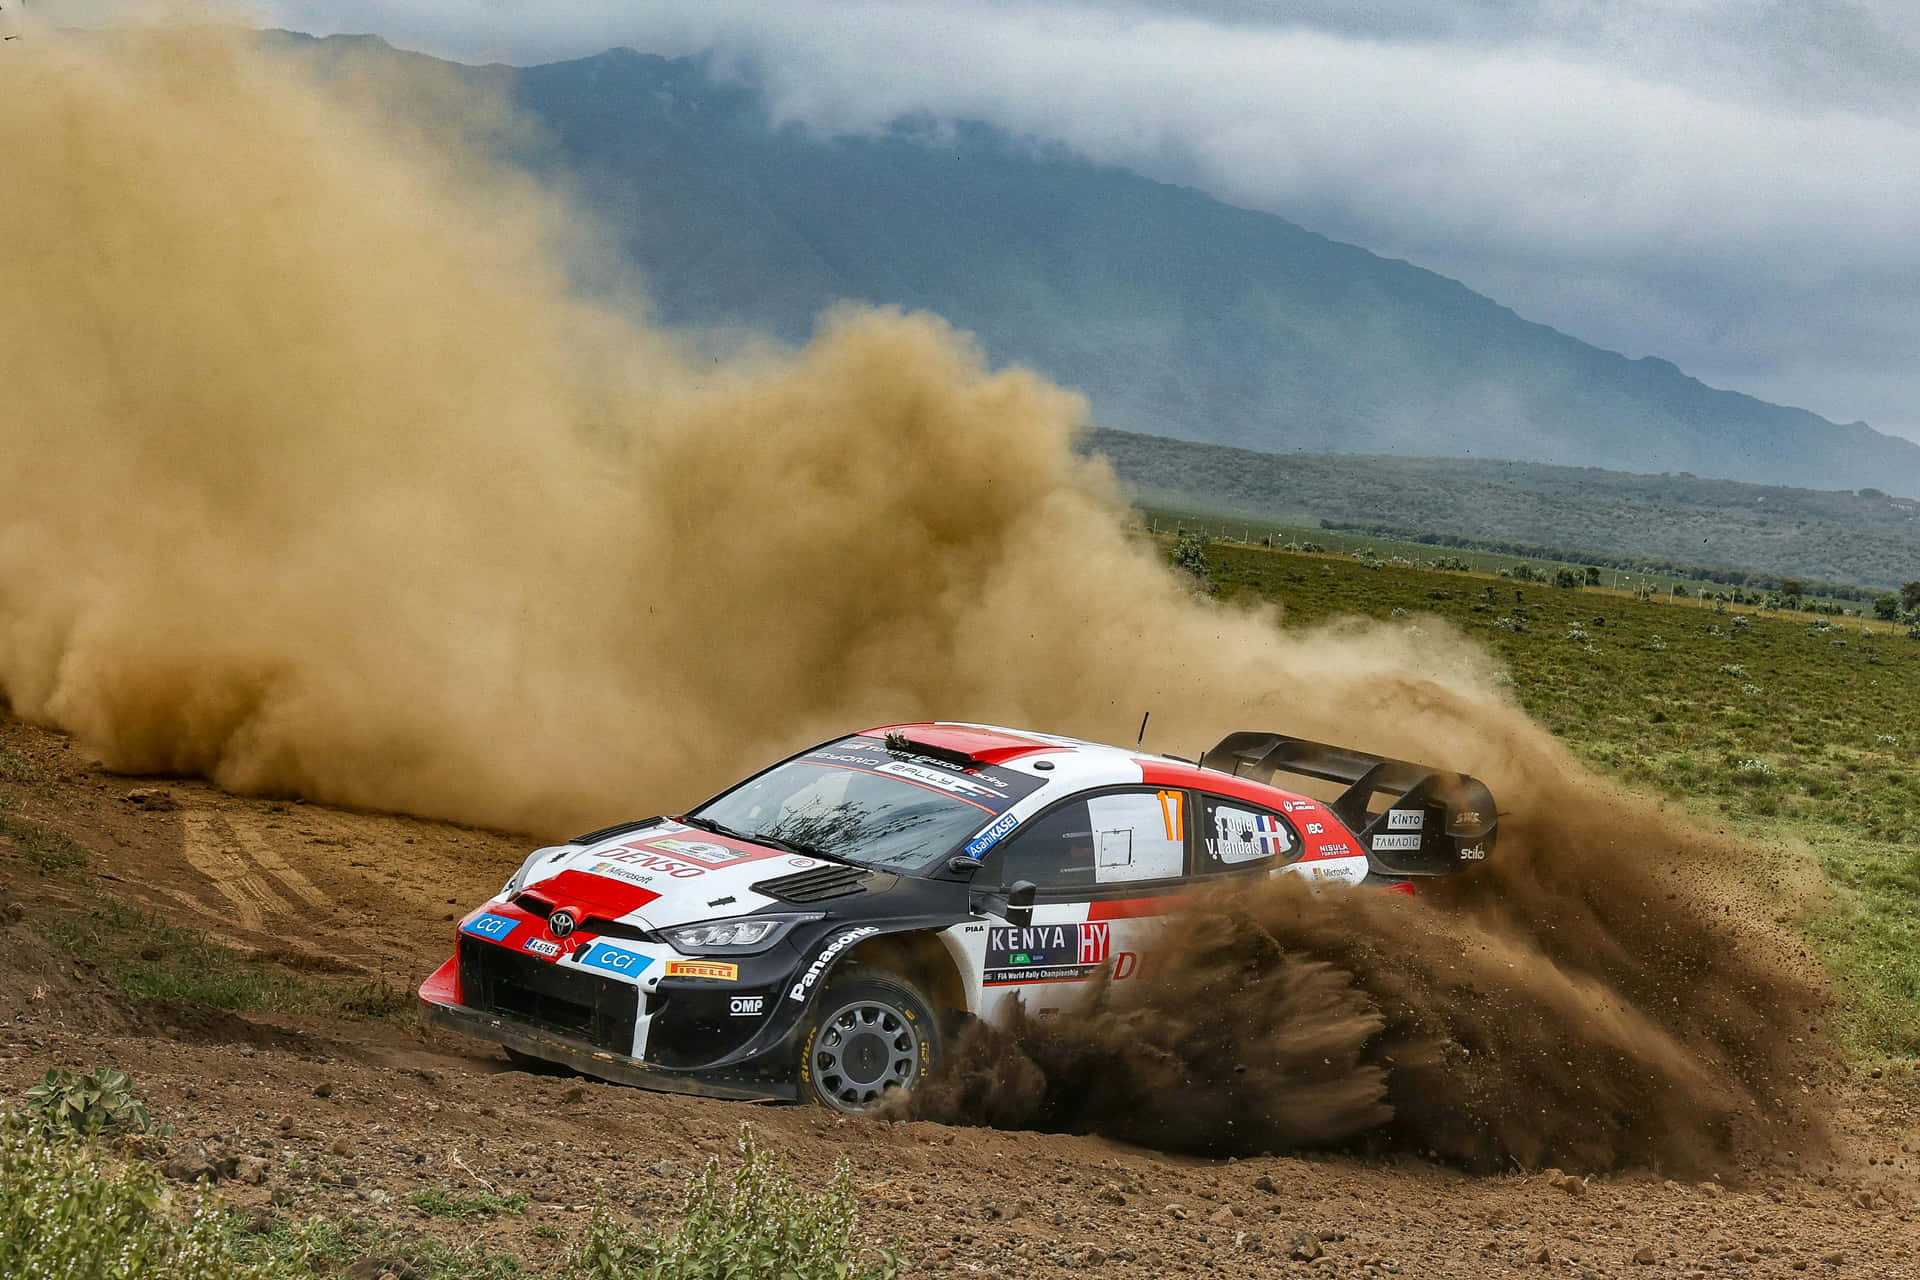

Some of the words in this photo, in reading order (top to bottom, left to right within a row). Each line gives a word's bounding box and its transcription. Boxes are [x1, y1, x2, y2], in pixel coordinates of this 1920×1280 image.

[889, 764, 955, 785] RALLY
[917, 755, 965, 771] GAZOO
[963, 768, 1009, 788] Racing
[1157, 790, 1184, 841] 17
[1391, 813, 1420, 825] KINTO
[970, 814, 1018, 857] AsahiKASEI
[1375, 837, 1419, 848] TAMADIC
[1204, 837, 1262, 855] V.Landais
[1319, 842, 1349, 853] NISULA
[1460, 845, 1485, 860] Stilo
[593, 848, 706, 878] DENSO
[606, 866, 653, 884] Microsoft
[964, 925, 985, 933] PIAA
[991, 926, 1066, 951] KENYA
[1079, 923, 1110, 962] HY
[670, 962, 733, 977] PIRELLI
[789, 925, 880, 1002] Panasonic
[997, 972, 1008, 980] FIA
[1008, 971, 1025, 980] World
[1025, 970, 1040, 979] Rally
[1040, 968, 1079, 979] Championship
[729, 998, 764, 1013] OMP
